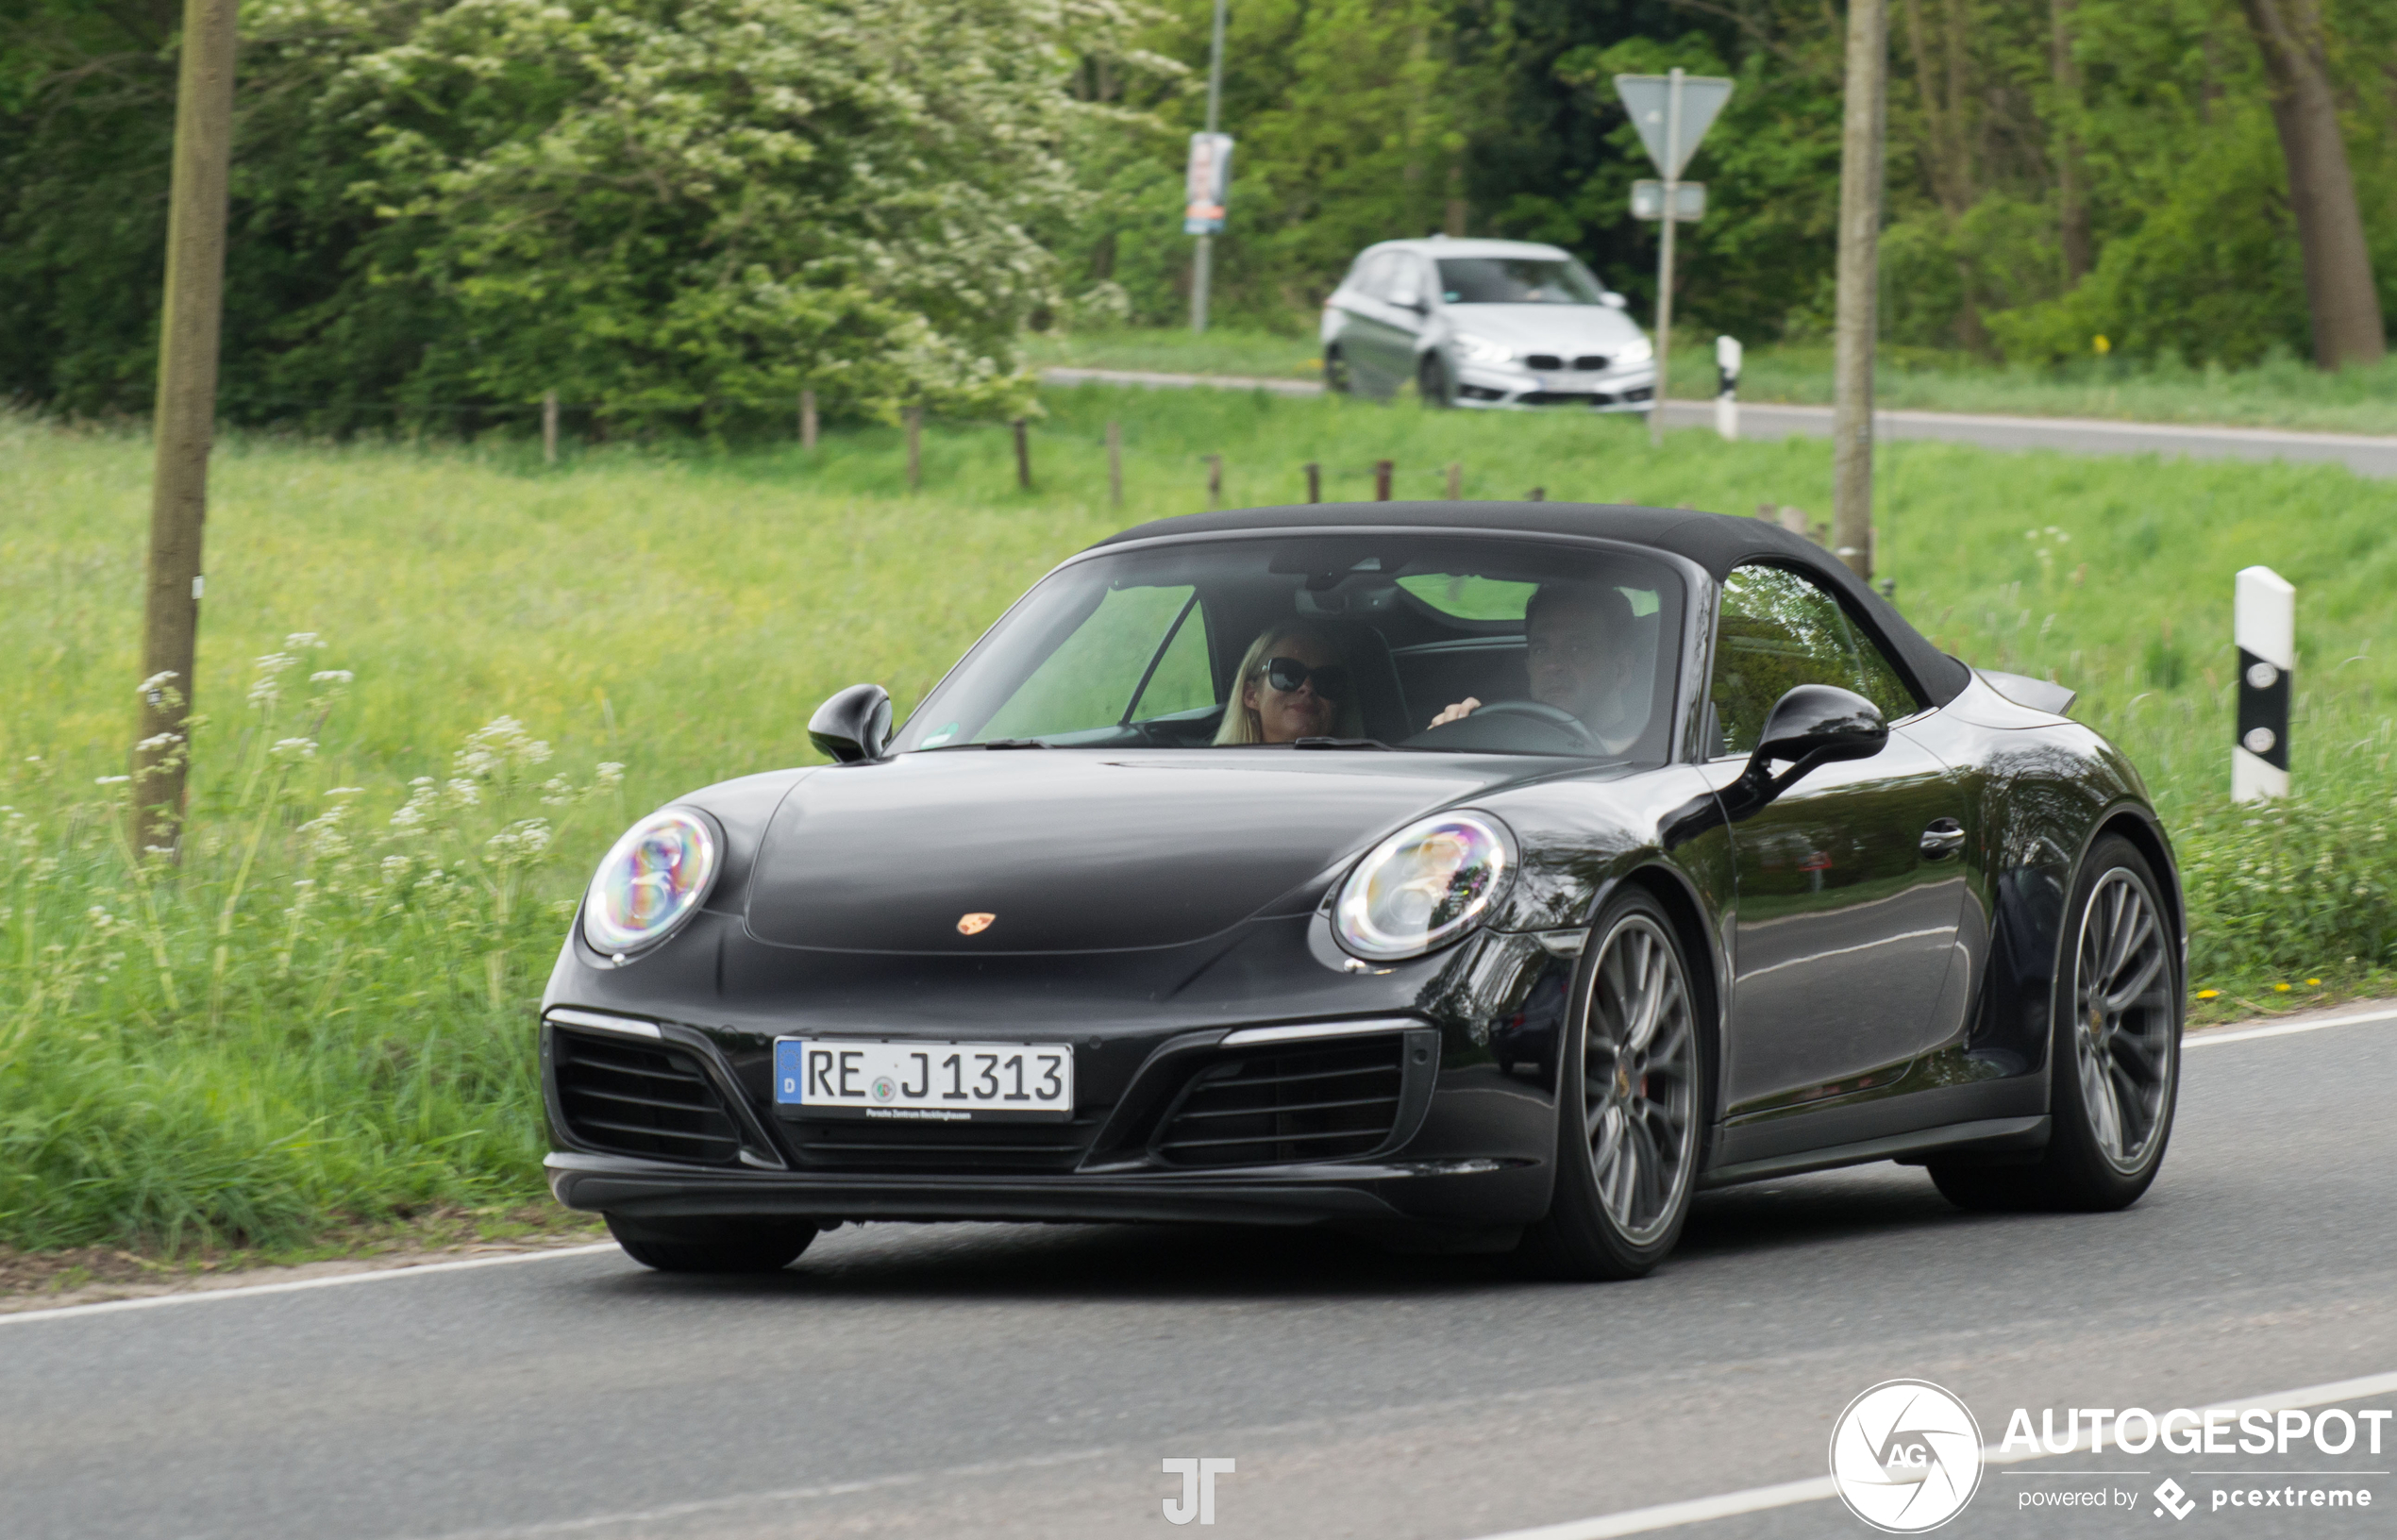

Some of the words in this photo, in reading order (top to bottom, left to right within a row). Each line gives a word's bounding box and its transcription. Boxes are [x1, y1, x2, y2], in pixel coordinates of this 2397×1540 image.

[784, 1078, 796, 1094] D
[809, 1049, 865, 1097] RE
[901, 1052, 929, 1098] J
[942, 1053, 1063, 1100] 1313
